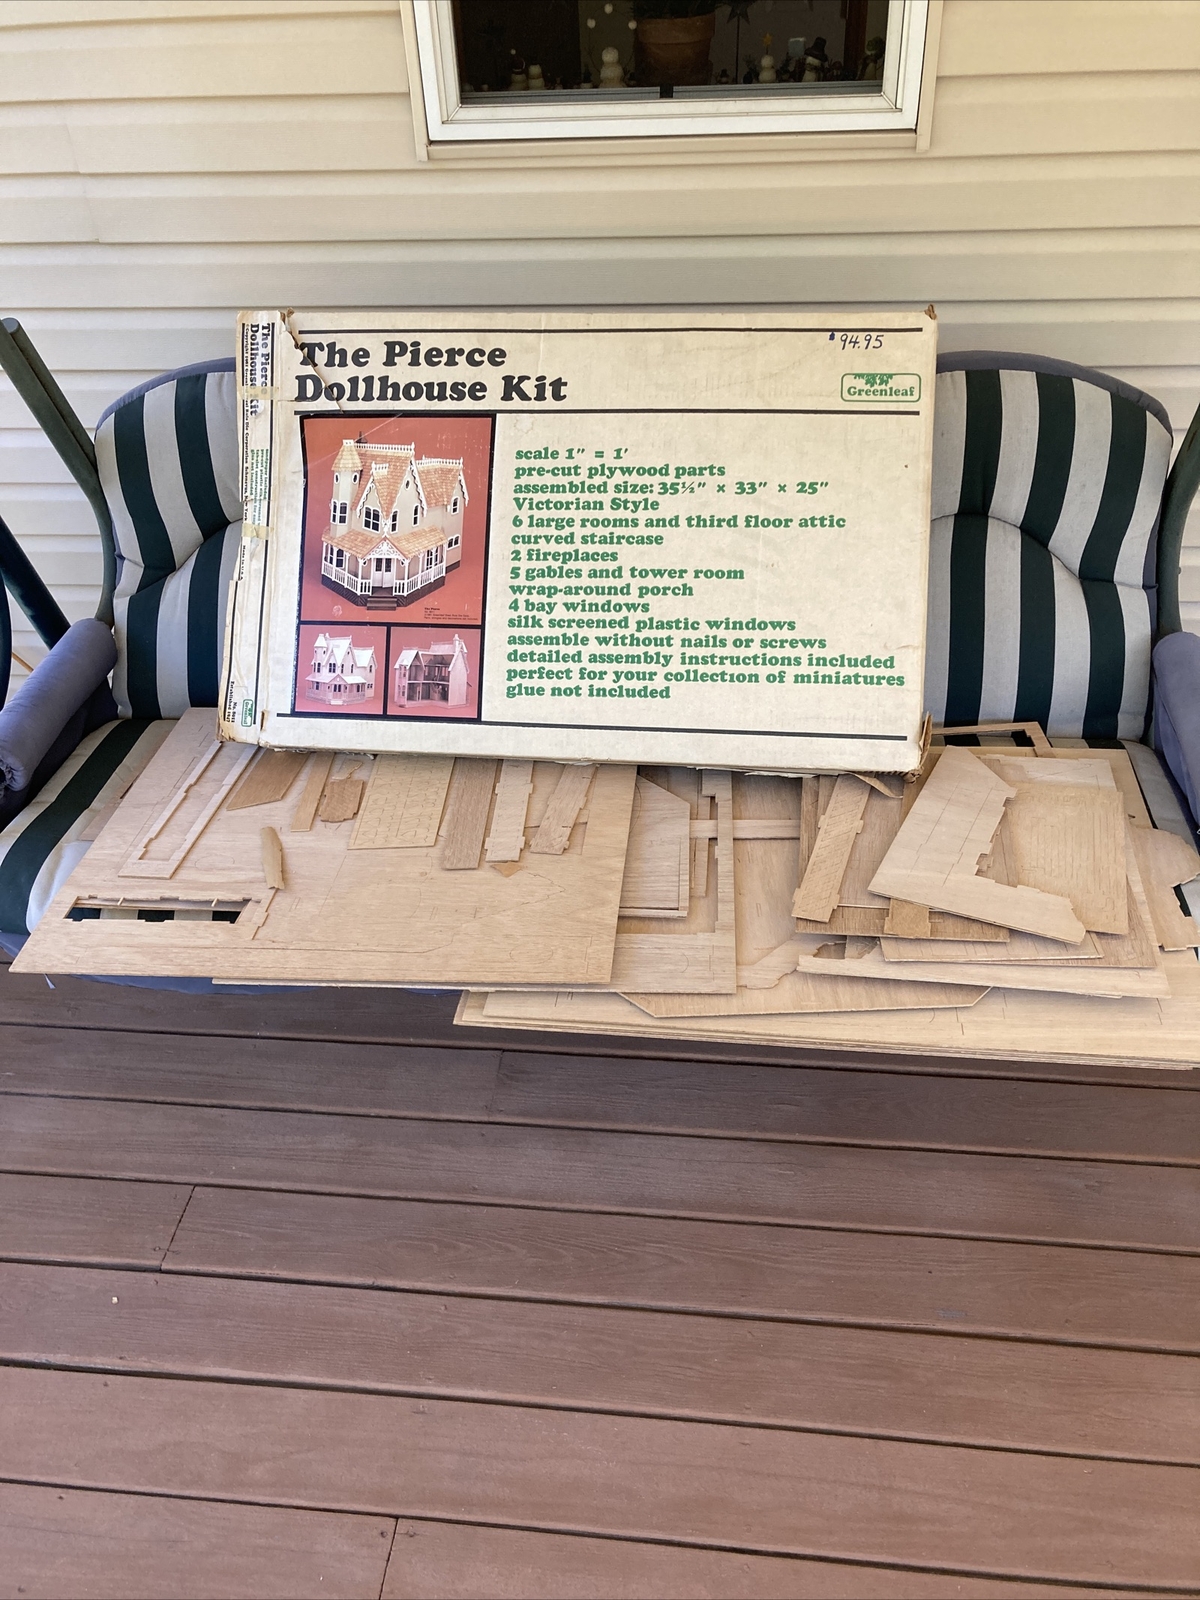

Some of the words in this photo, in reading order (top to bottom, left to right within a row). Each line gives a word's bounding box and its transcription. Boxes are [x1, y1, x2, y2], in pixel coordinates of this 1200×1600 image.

[261, 323, 271, 349] The
[249, 323, 260, 390] Dollhouse
[299, 341, 370, 368] The
[382, 341, 507, 367] Pierce
[294, 374, 488, 402] Dollhouse
[500, 375, 568, 402] Kit
[847, 386, 915, 397] Greenleaf
[515, 447, 560, 460] scale
[594, 450, 605, 459] =
[514, 464, 581, 479] pre-cut
[587, 463, 670, 479] plywood
[674, 465, 726, 479] parts
[513, 481, 609, 495] assembled
[613, 480, 654, 495] size:
[513, 497, 605, 512] Victorian
[609, 497, 660, 513] Style
[512, 515, 523, 529] 6
[527, 514, 576, 532] large
[579, 517, 640, 529] rooms
[644, 515, 681, 529] and
[685, 515, 739, 529] third
[744, 515, 794, 529] floor
[798, 515, 847, 529] attic
[511, 532, 576, 546] curved
[580, 532, 665, 546] staircase
[510, 549, 522, 562] 2
[526, 548, 619, 564] fireplaces
[509, 566, 521, 580] 5
[525, 565, 583, 581] gables
[587, 565, 624, 579] and
[629, 566, 689, 580] tower
[693, 568, 745, 580] room
[508, 583, 632, 599] wrap-around
[637, 583, 694, 599] porch
[508, 598, 520, 613] 4
[524, 598, 558, 615] bay
[562, 600, 651, 614] windows
[507, 614, 544, 630] silk
[547, 615, 630, 630] screened
[635, 617, 701, 633] plastic
[705, 617, 797, 632] windows
[506, 632, 591, 647] assemble
[594, 633, 674, 648] without
[680, 635, 728, 649] nails
[732, 638, 755, 649] or
[759, 638, 828, 650] screws
[506, 649, 583, 664] detailed
[587, 651, 674, 668] assembly
[679, 652, 803, 667] instructions
[807, 654, 896, 670] included
[505, 666, 574, 682] perfect
[577, 667, 609, 682] for
[612, 670, 658, 684] your
[663, 669, 761, 684] collection
[765, 670, 786, 684] of
[792, 671, 906, 687] miniatures
[227, 680, 235, 710] Established
[505, 683, 547, 699] glue
[550, 684, 582, 698] not
[587, 684, 671, 700] included
